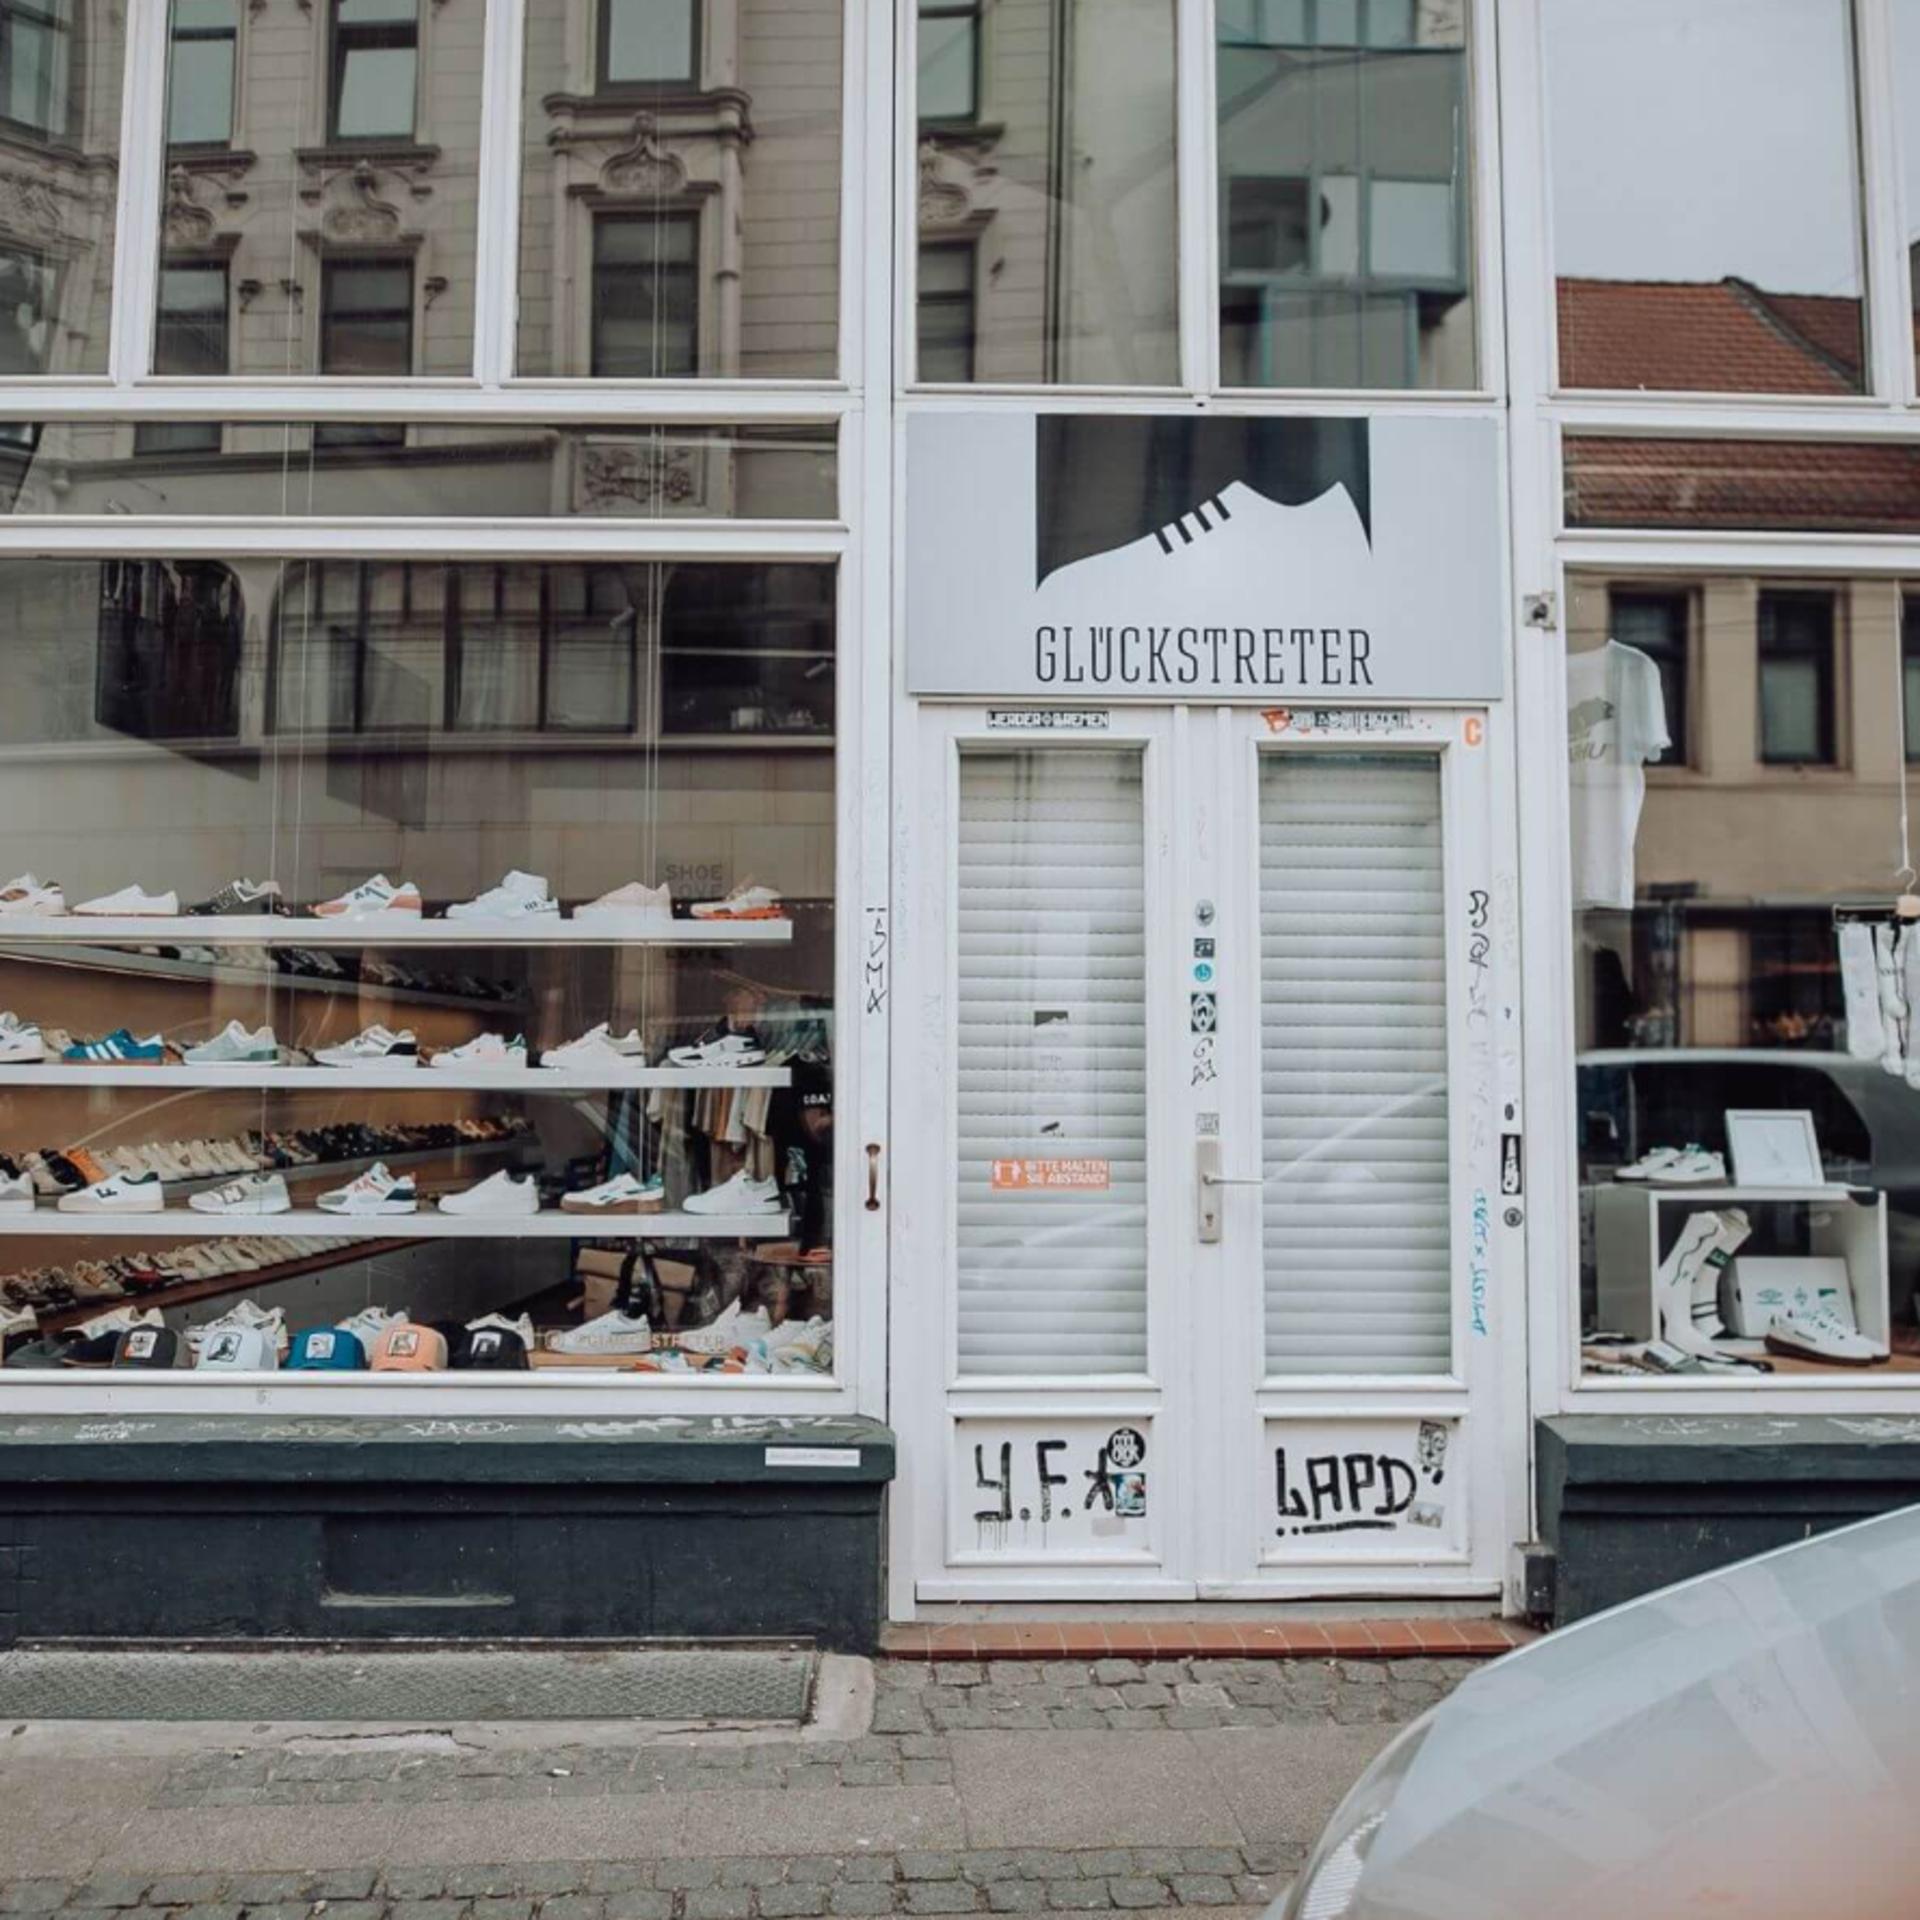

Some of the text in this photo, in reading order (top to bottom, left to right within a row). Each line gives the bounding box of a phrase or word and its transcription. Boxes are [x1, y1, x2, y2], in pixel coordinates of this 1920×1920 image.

[1036, 626, 1373, 686] GLÜCKSTRETER
[665, 864, 723, 881] SHOE
[1025, 1160, 1107, 1173] BITTE HALTEN
[1025, 1173, 1044, 1186] SIE
